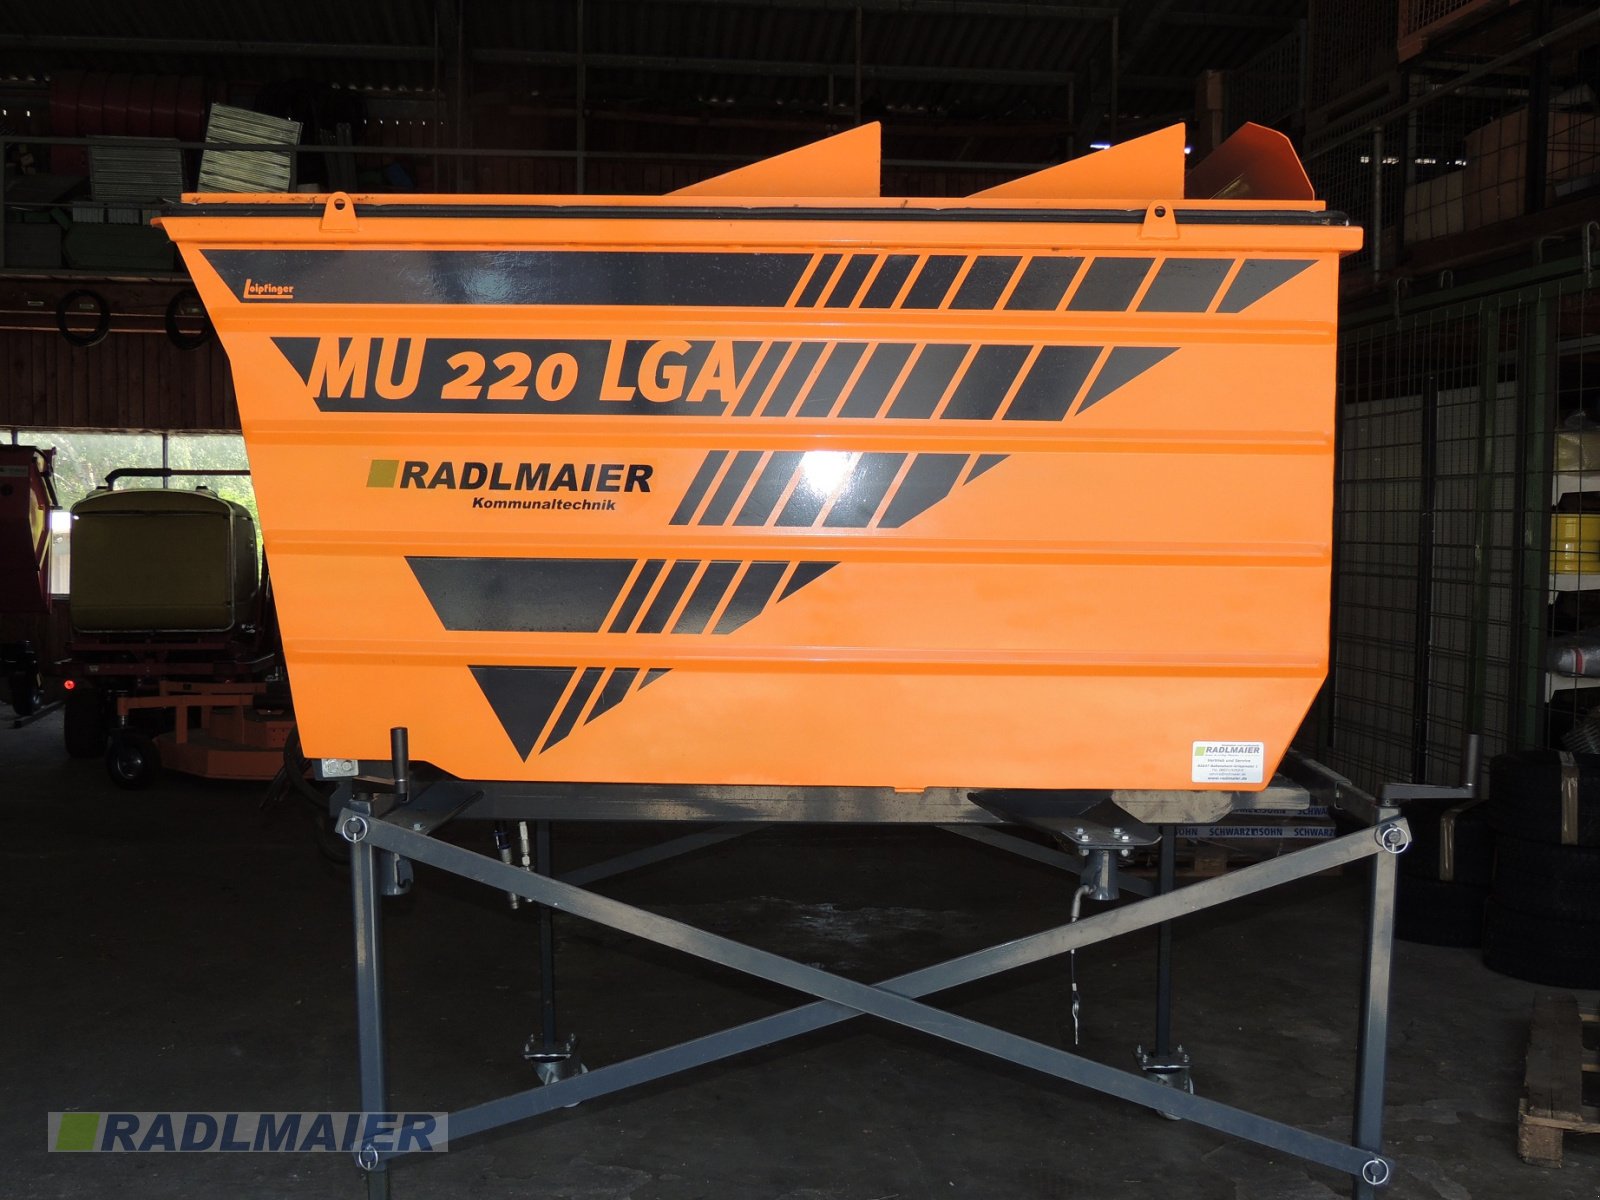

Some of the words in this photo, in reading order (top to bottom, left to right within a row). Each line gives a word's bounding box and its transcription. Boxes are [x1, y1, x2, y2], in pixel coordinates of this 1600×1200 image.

[306, 337, 427, 399] MU
[440, 351, 579, 402] 220
[599, 339, 733, 402] LGA
[400, 460, 654, 493] RADLMAIER
[472, 497, 616, 511] Kommunaltechnik
[1206, 746, 1260, 754] RADLMAIER
